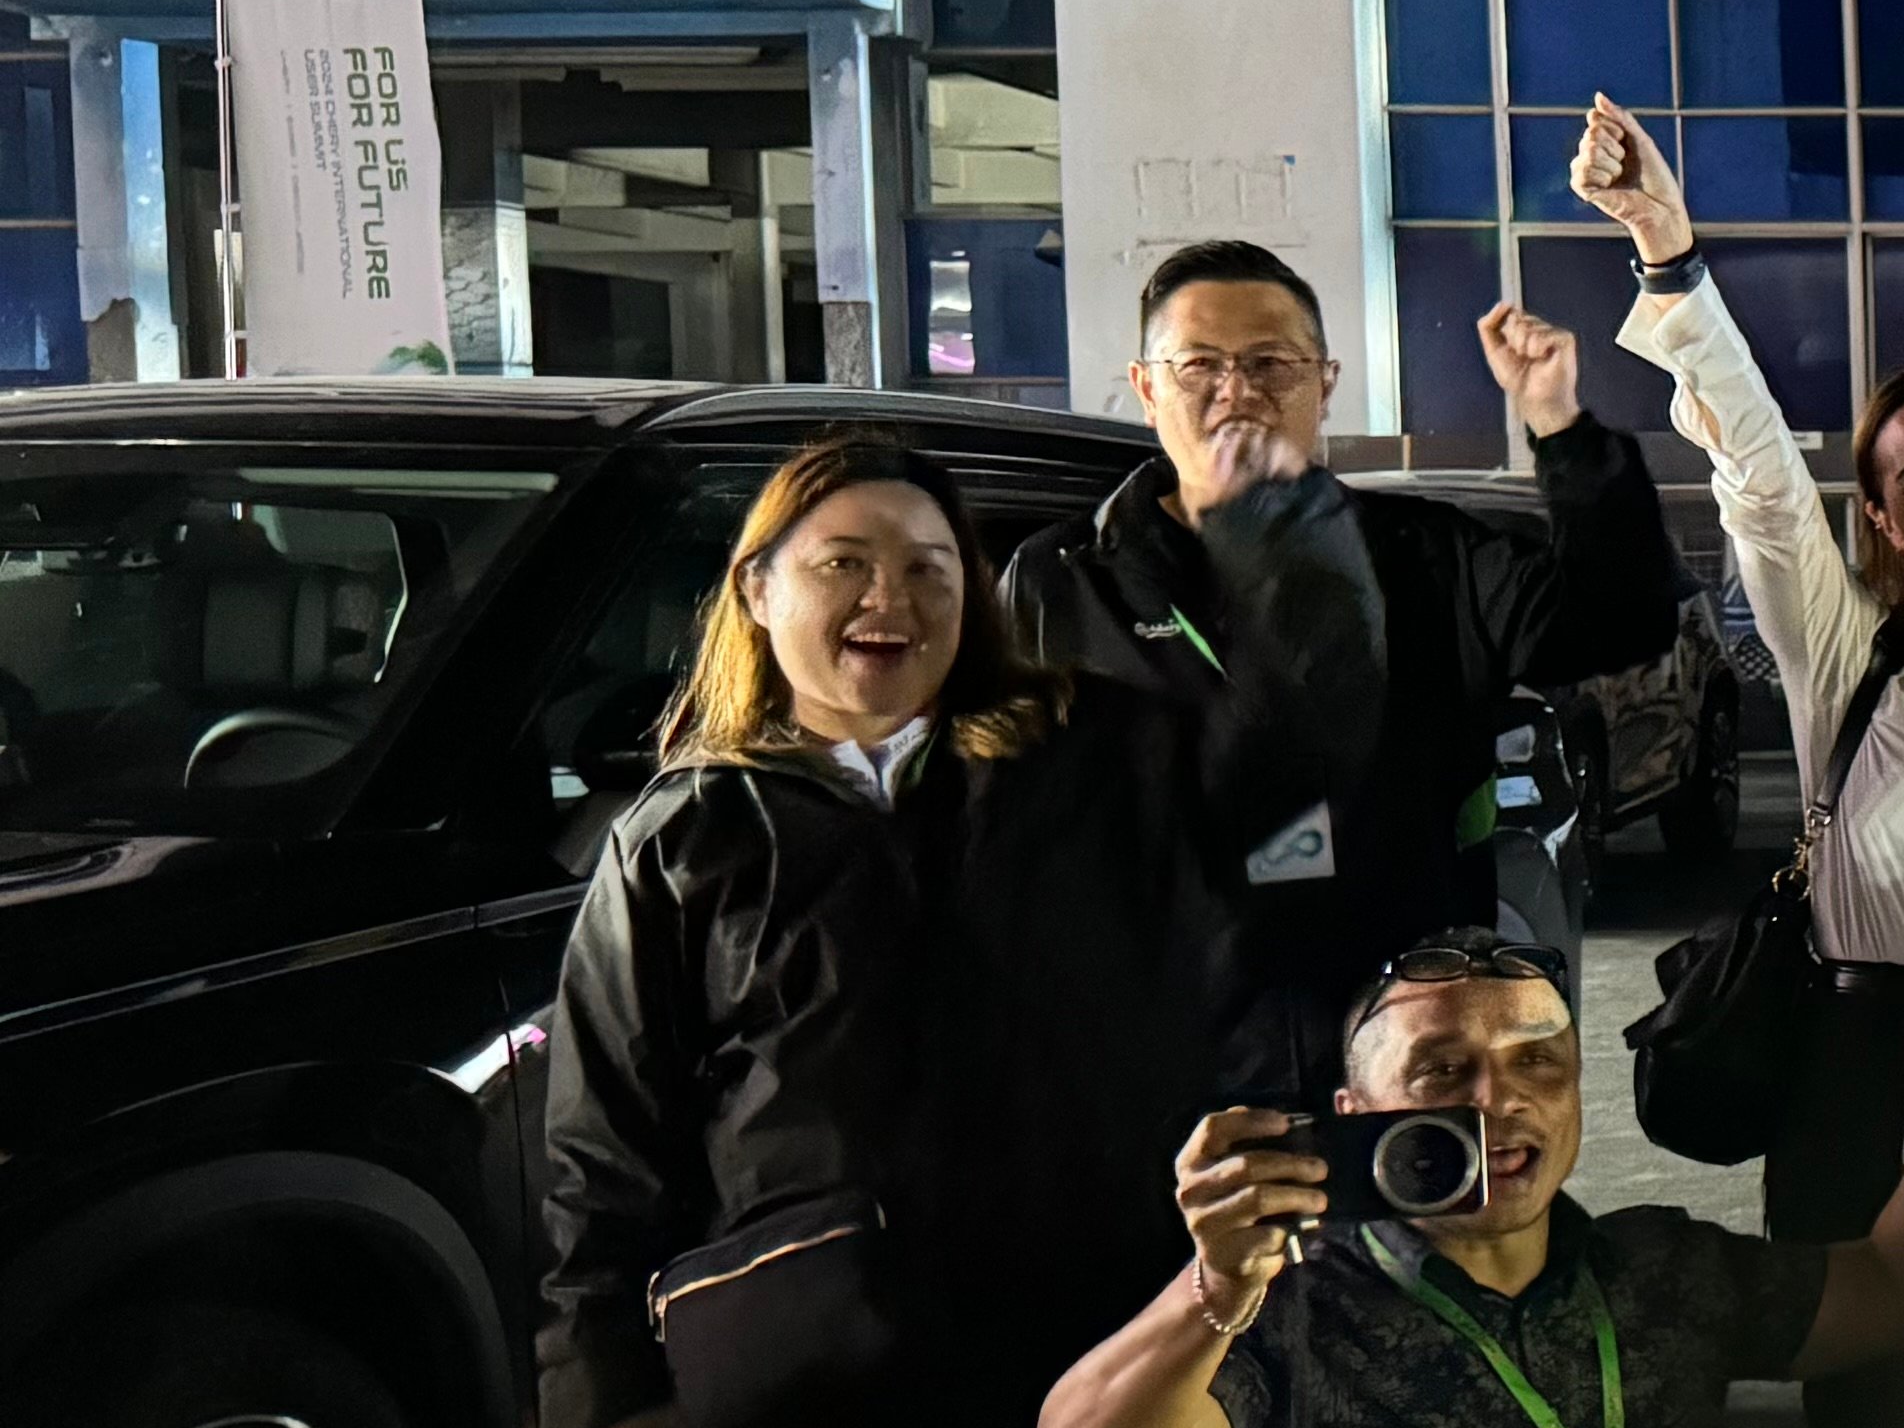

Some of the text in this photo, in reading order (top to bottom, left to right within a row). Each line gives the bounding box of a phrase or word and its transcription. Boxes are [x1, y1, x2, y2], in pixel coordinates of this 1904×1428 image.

[343, 48, 391, 300] FOR FUTURE
[373, 46, 408, 191] FOR US
